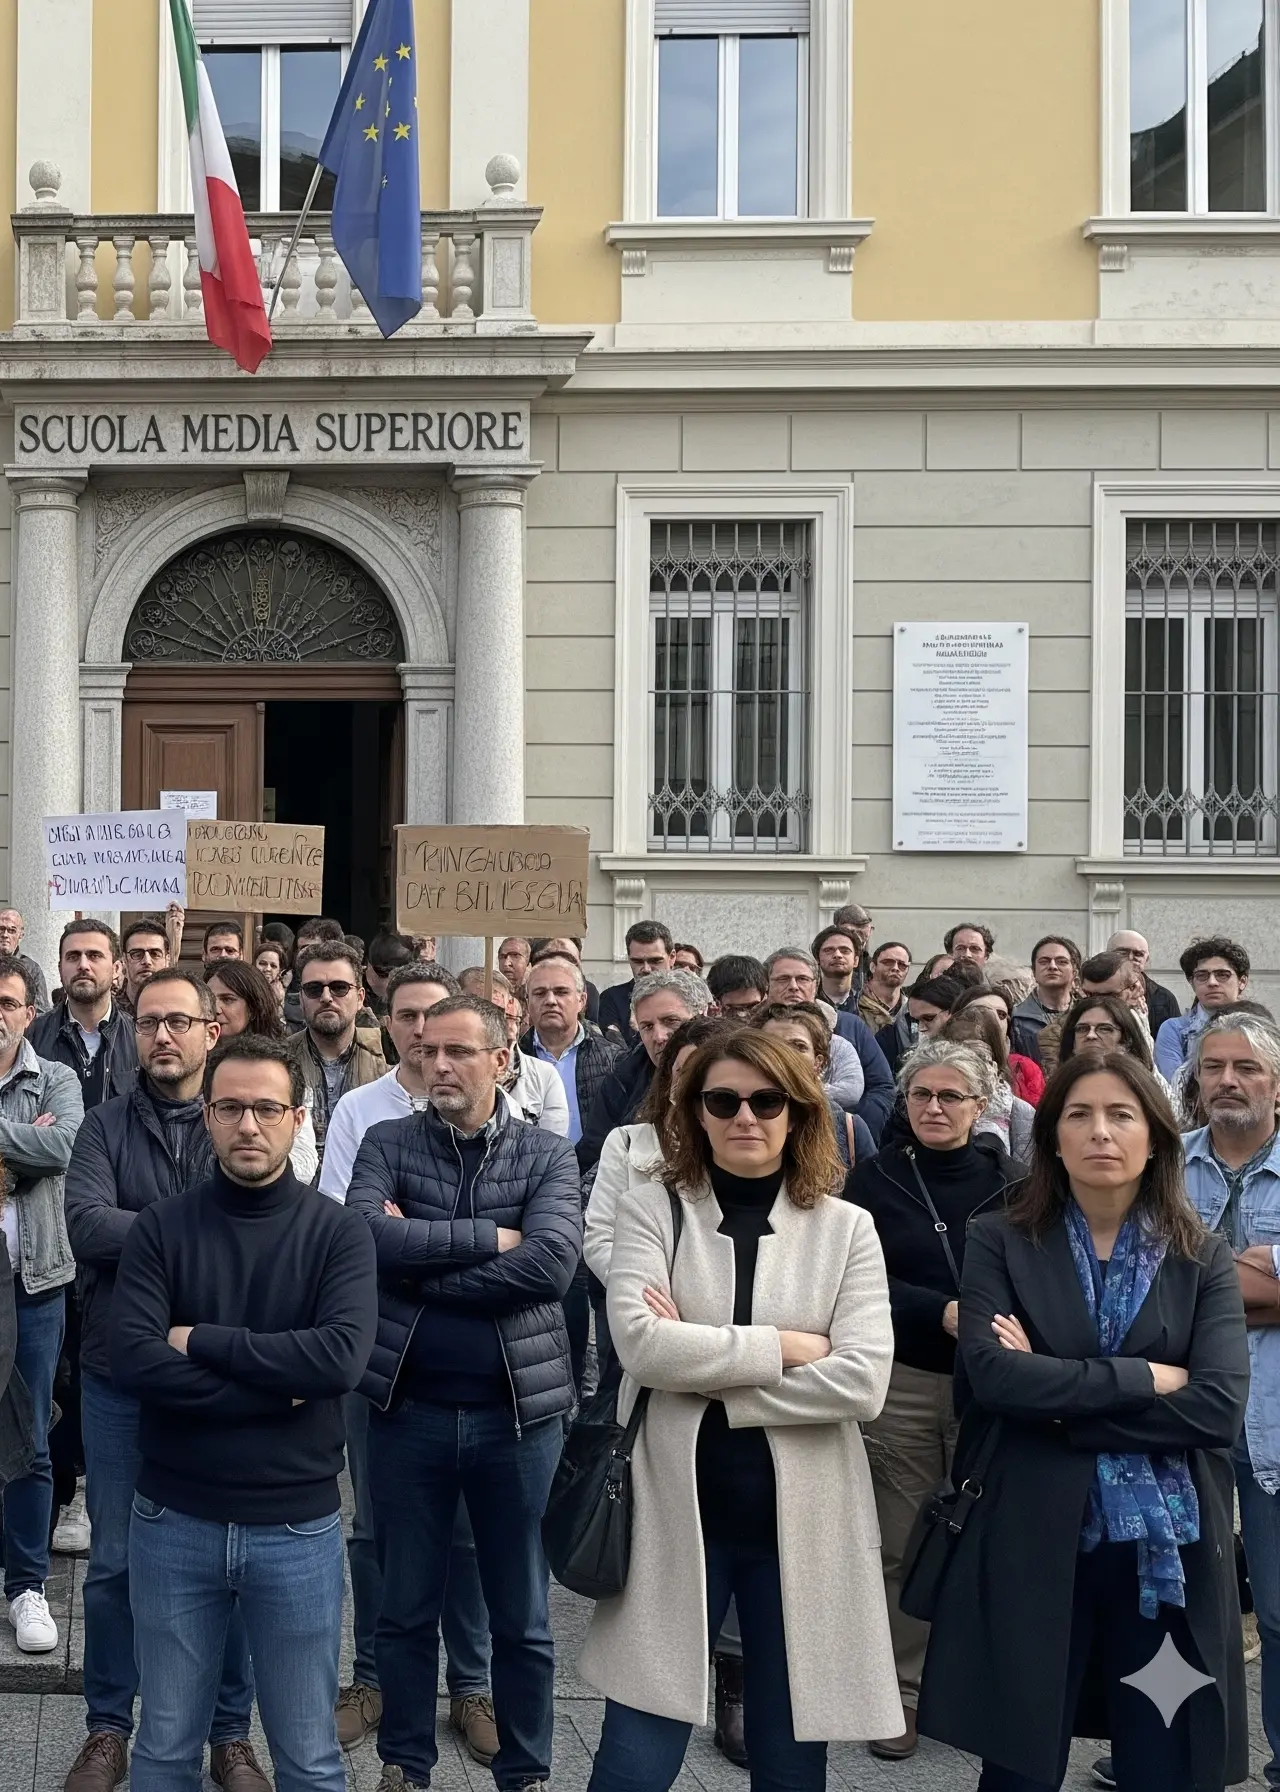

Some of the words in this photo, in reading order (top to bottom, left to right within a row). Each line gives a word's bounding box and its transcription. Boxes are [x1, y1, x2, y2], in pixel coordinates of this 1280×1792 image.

[19, 413, 167, 453] SCUOLA
[181, 413, 300, 452] MEDIA
[316, 411, 524, 451] SUPERIORE
